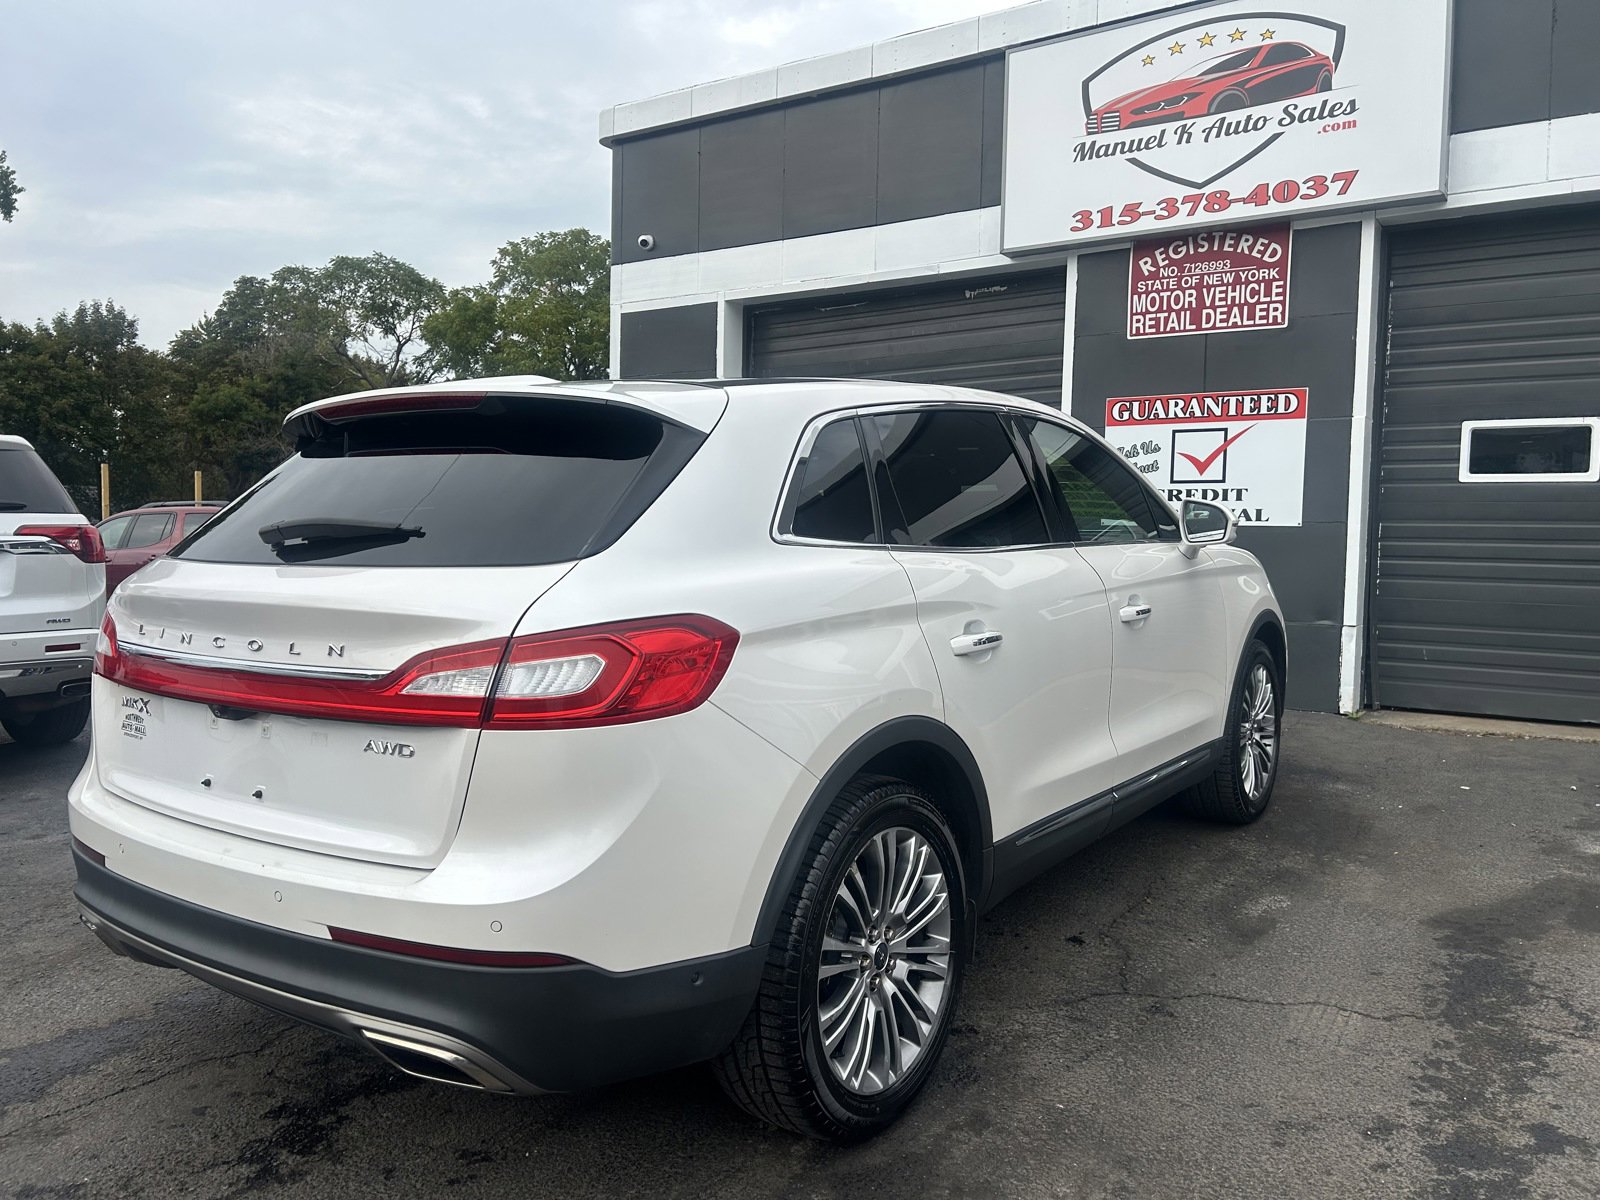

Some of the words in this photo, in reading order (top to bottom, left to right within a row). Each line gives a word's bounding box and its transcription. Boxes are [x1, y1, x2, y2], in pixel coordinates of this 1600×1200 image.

[1073, 129, 1168, 163] Manuel
[1174, 122, 1197, 145] K
[1201, 115, 1274, 143] Auto
[1277, 98, 1360, 127] Sales
[1317, 119, 1358, 134] .com
[1070, 169, 1360, 232] 315-378-4037
[1138, 231, 1283, 277] REGISTERED
[1137, 278, 1178, 292] STATE
[1181, 275, 1201, 288] OF
[1203, 272, 1235, 286] NEW
[1238, 267, 1280, 282] YORK
[1159, 266, 1182, 278] NO.
[1183, 259, 1232, 275] 7126993
[1132, 289, 1197, 314] MOTOR
[1202, 281, 1284, 307] VEHICLE
[1132, 310, 1197, 335] RETAIL
[1201, 302, 1283, 329] DEALER
[1111, 393, 1298, 421] GUARANTEED
[1140, 440, 1161, 456] Us
[1132, 459, 1160, 474] out
[138, 624, 346, 657] LINCOLN
[122, 696, 151, 716] MKX
[363, 739, 415, 758] AWD
